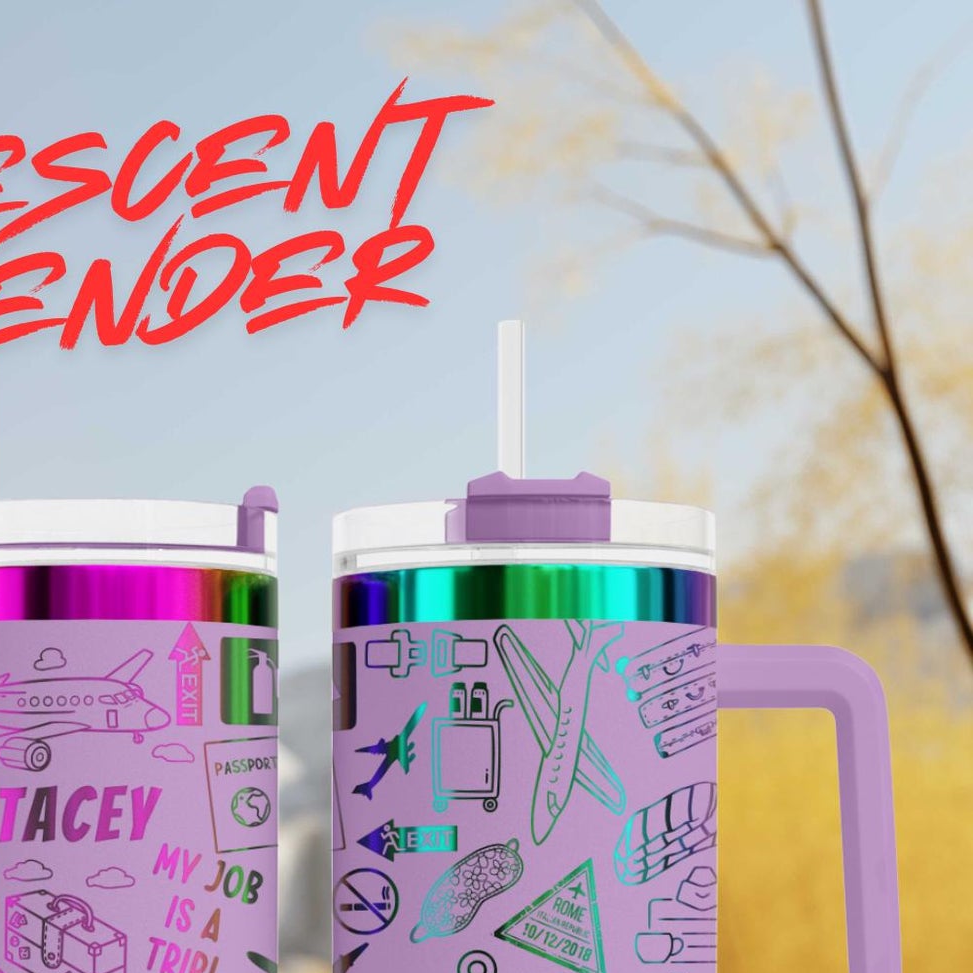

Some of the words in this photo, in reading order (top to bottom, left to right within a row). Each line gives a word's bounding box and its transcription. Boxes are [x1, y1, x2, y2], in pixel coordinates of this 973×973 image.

[181, 674, 197, 722] EXIT
[407, 831, 454, 848] EXIT
[152, 843, 202, 884] MY
[204, 859, 263, 904] JOB
[164, 895, 195, 932] IS
[200, 908, 221, 942] A
[552, 896, 587, 923] ROME
[522, 923, 593, 962] 10/12/2018
